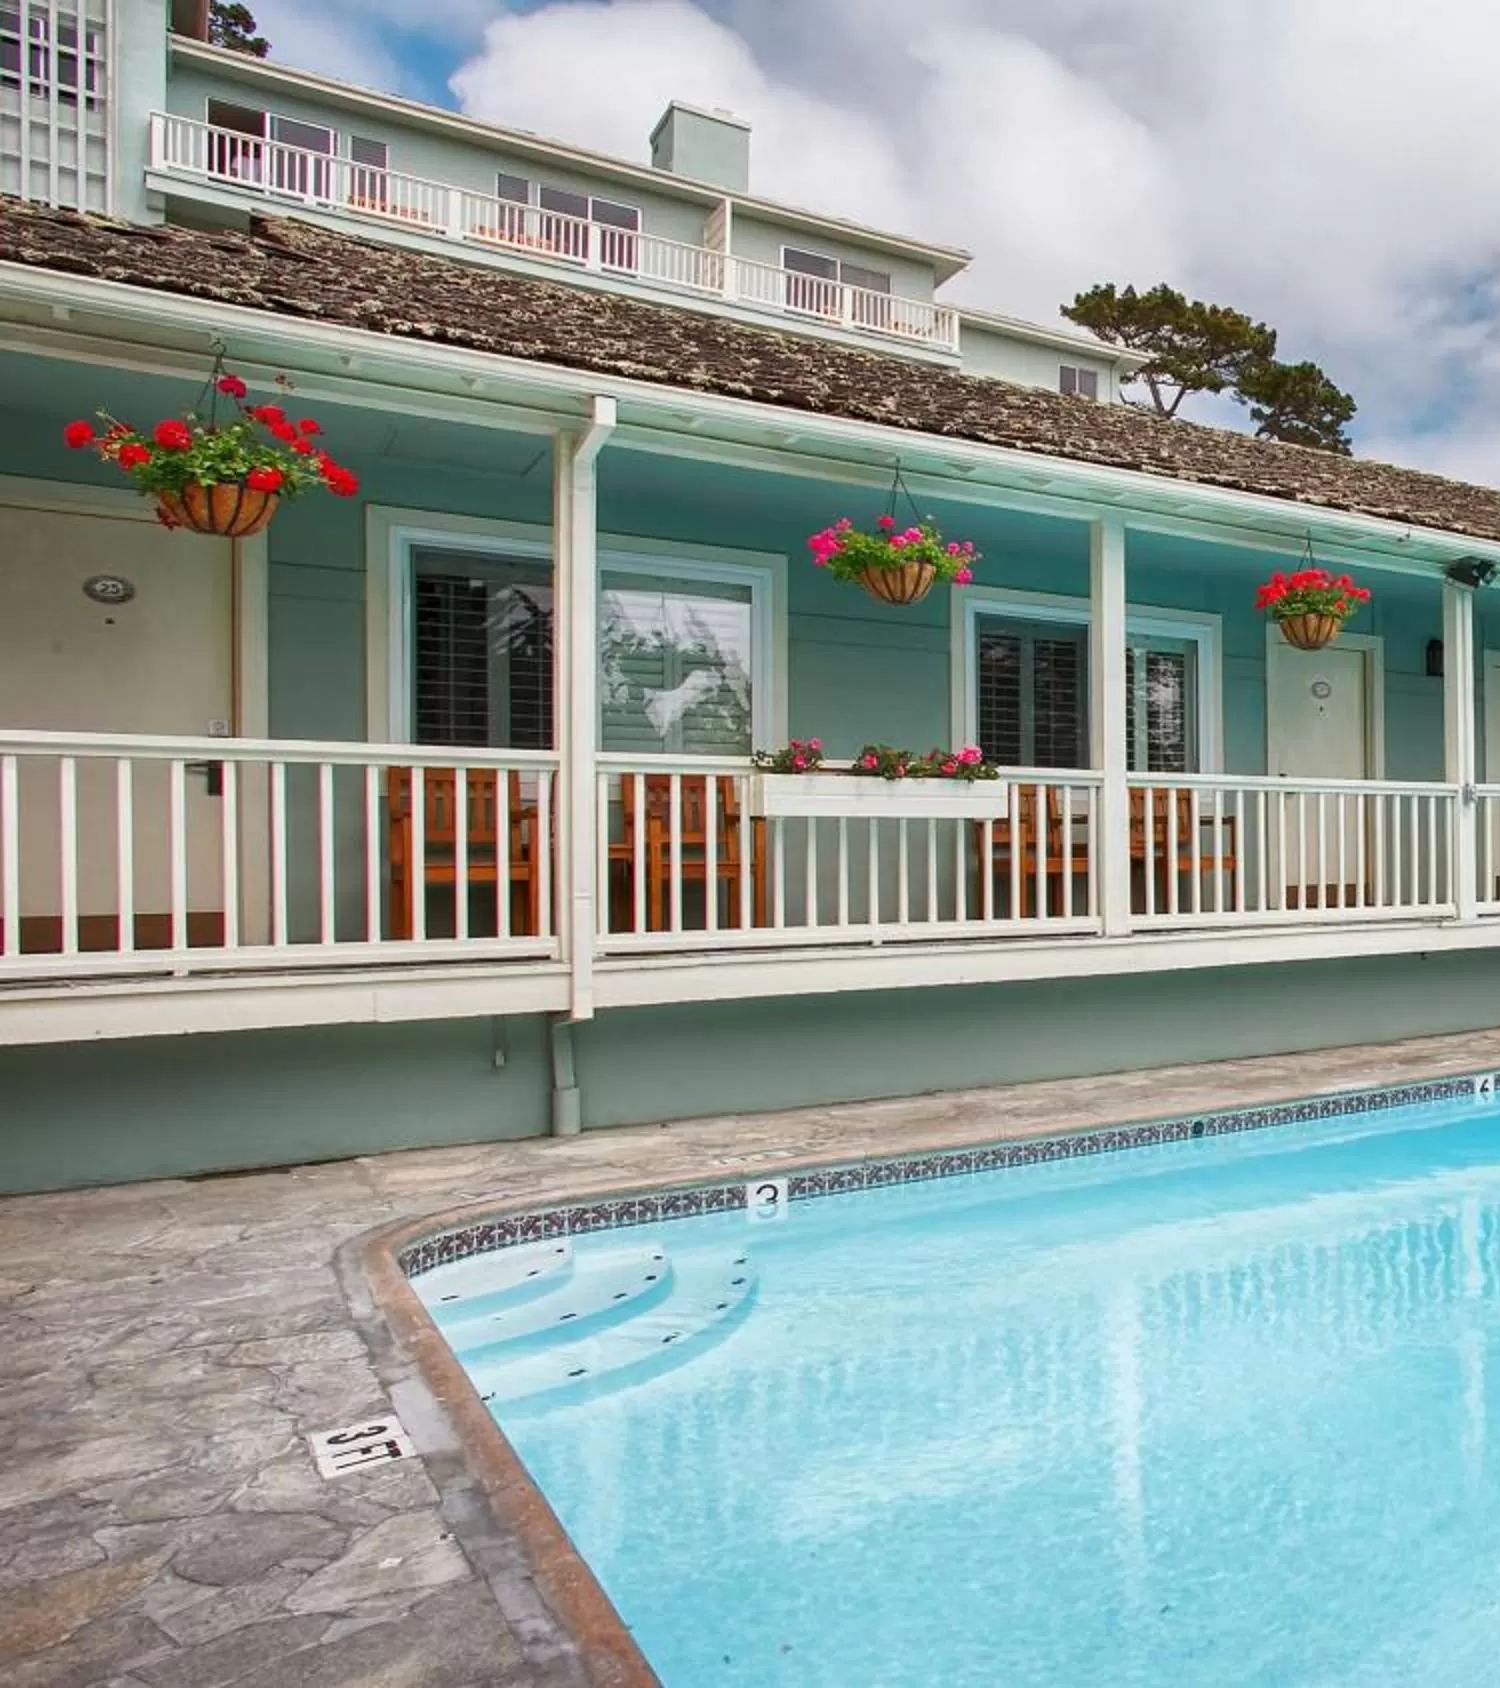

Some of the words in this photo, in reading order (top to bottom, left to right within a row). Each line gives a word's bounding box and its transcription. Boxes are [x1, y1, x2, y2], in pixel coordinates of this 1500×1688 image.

[756, 1183, 779, 1212] 3
[326, 1425, 389, 1445] 3
[331, 1439, 403, 1470] FT
